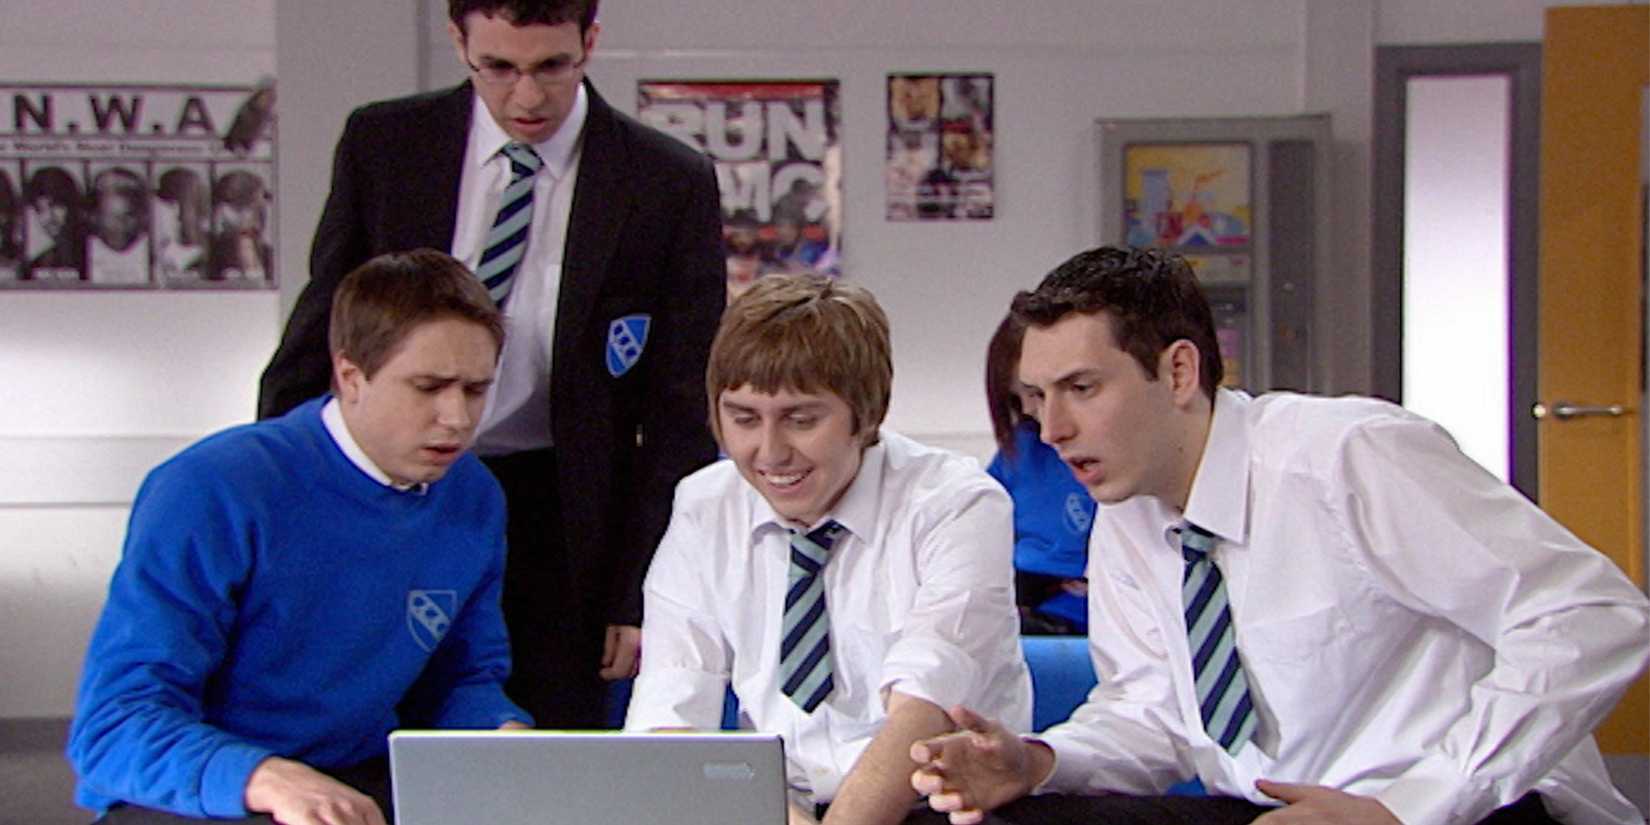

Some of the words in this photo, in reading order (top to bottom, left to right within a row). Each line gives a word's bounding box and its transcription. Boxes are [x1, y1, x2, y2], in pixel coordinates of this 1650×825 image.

[14, 94, 216, 132] N.W.A
[638, 98, 826, 161] RUN
[713, 160, 831, 223] MC
